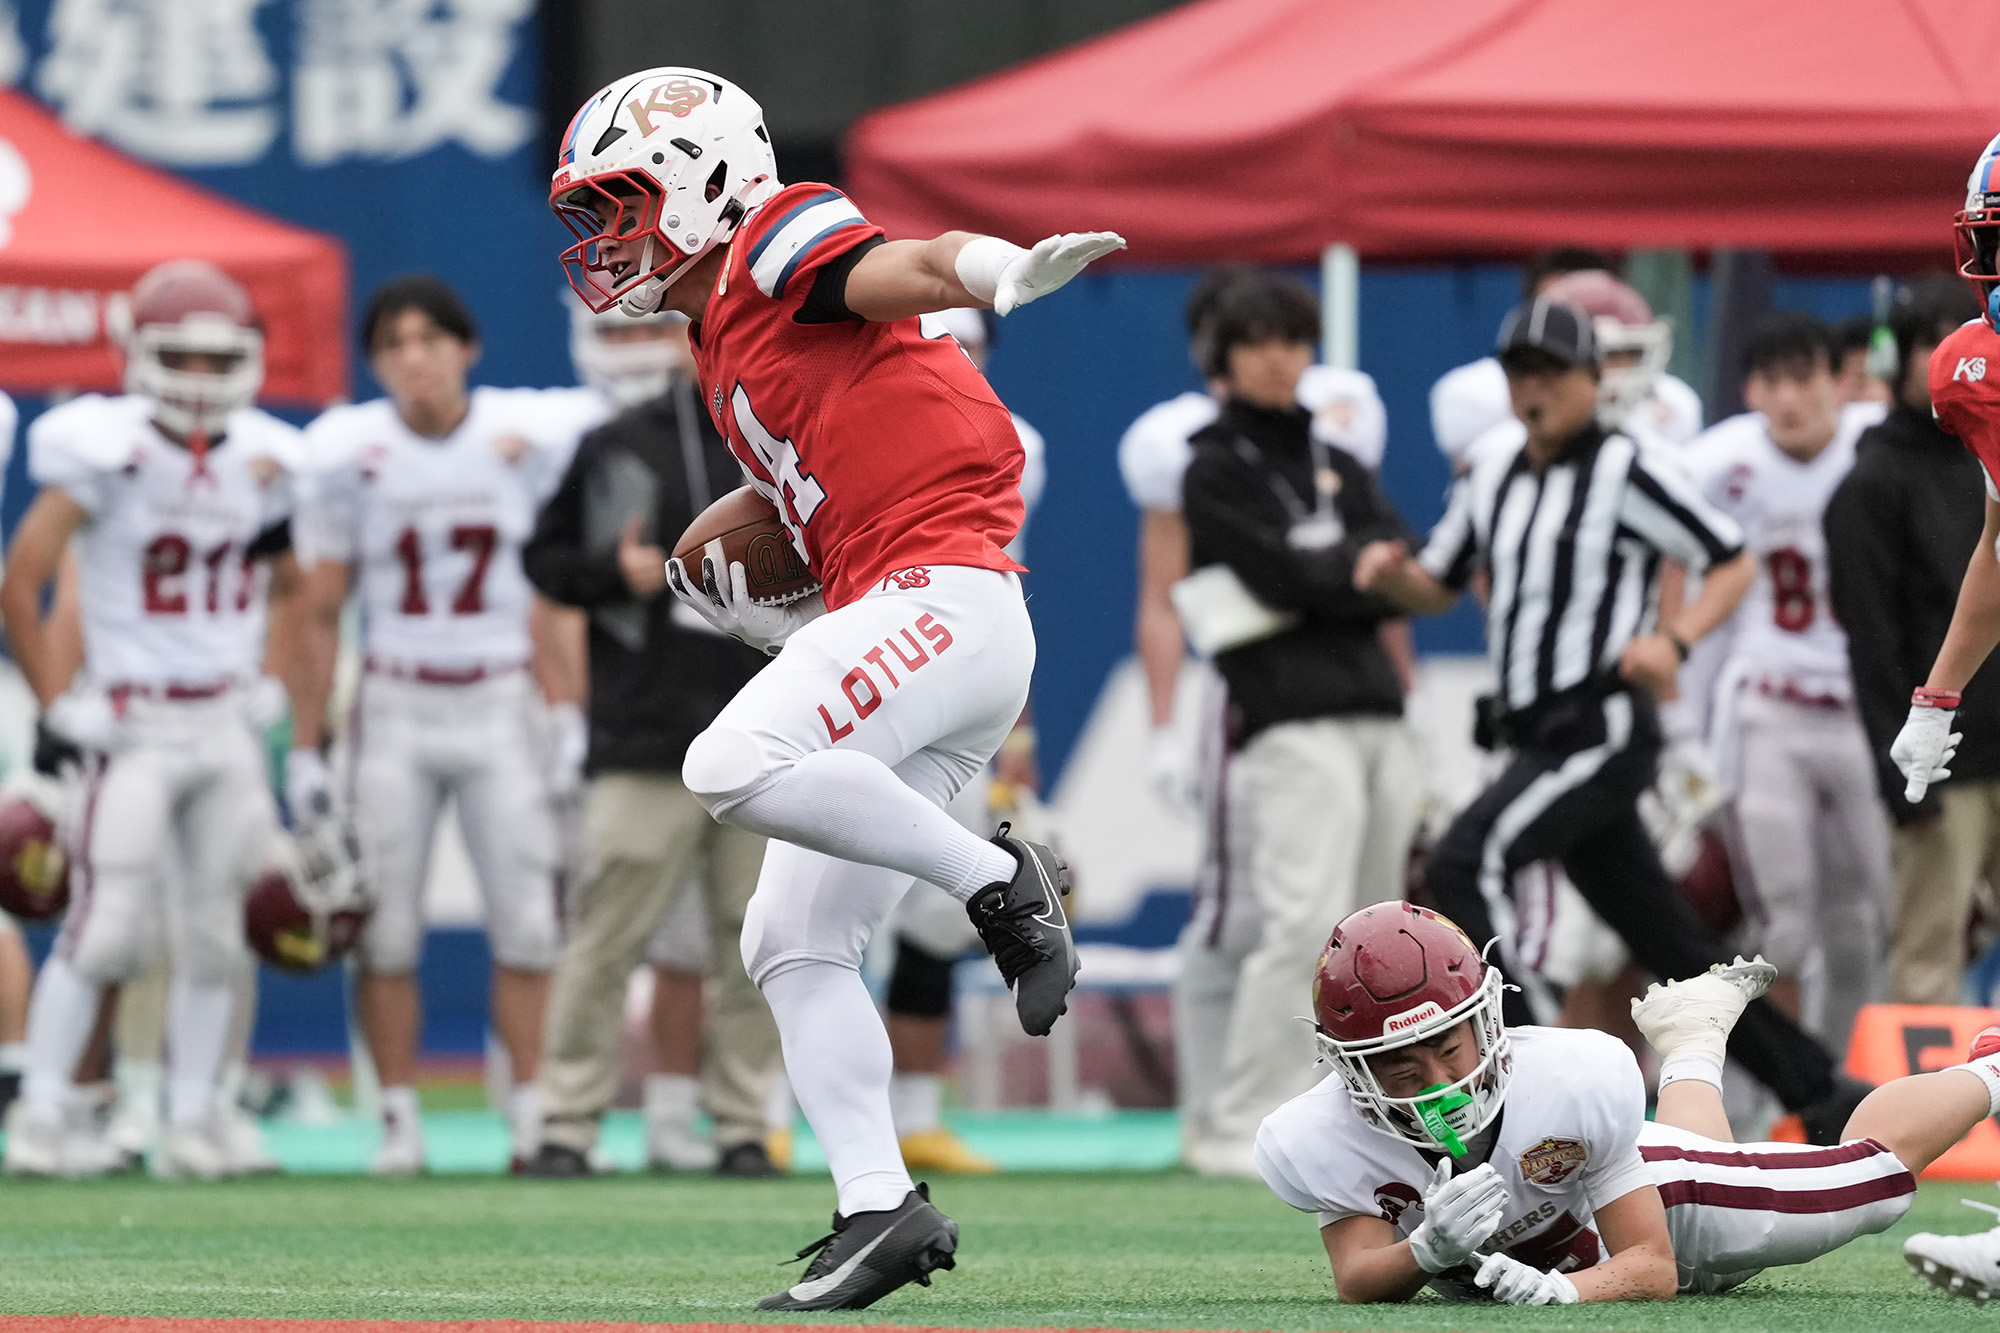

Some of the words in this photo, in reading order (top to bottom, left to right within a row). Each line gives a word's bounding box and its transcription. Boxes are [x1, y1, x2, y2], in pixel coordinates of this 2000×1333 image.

[0, 0, 535, 165] 建設
[397, 525, 498, 615] 17
[817, 612, 953, 744] LOTUS
[1388, 1007, 1436, 1032] Riddell
